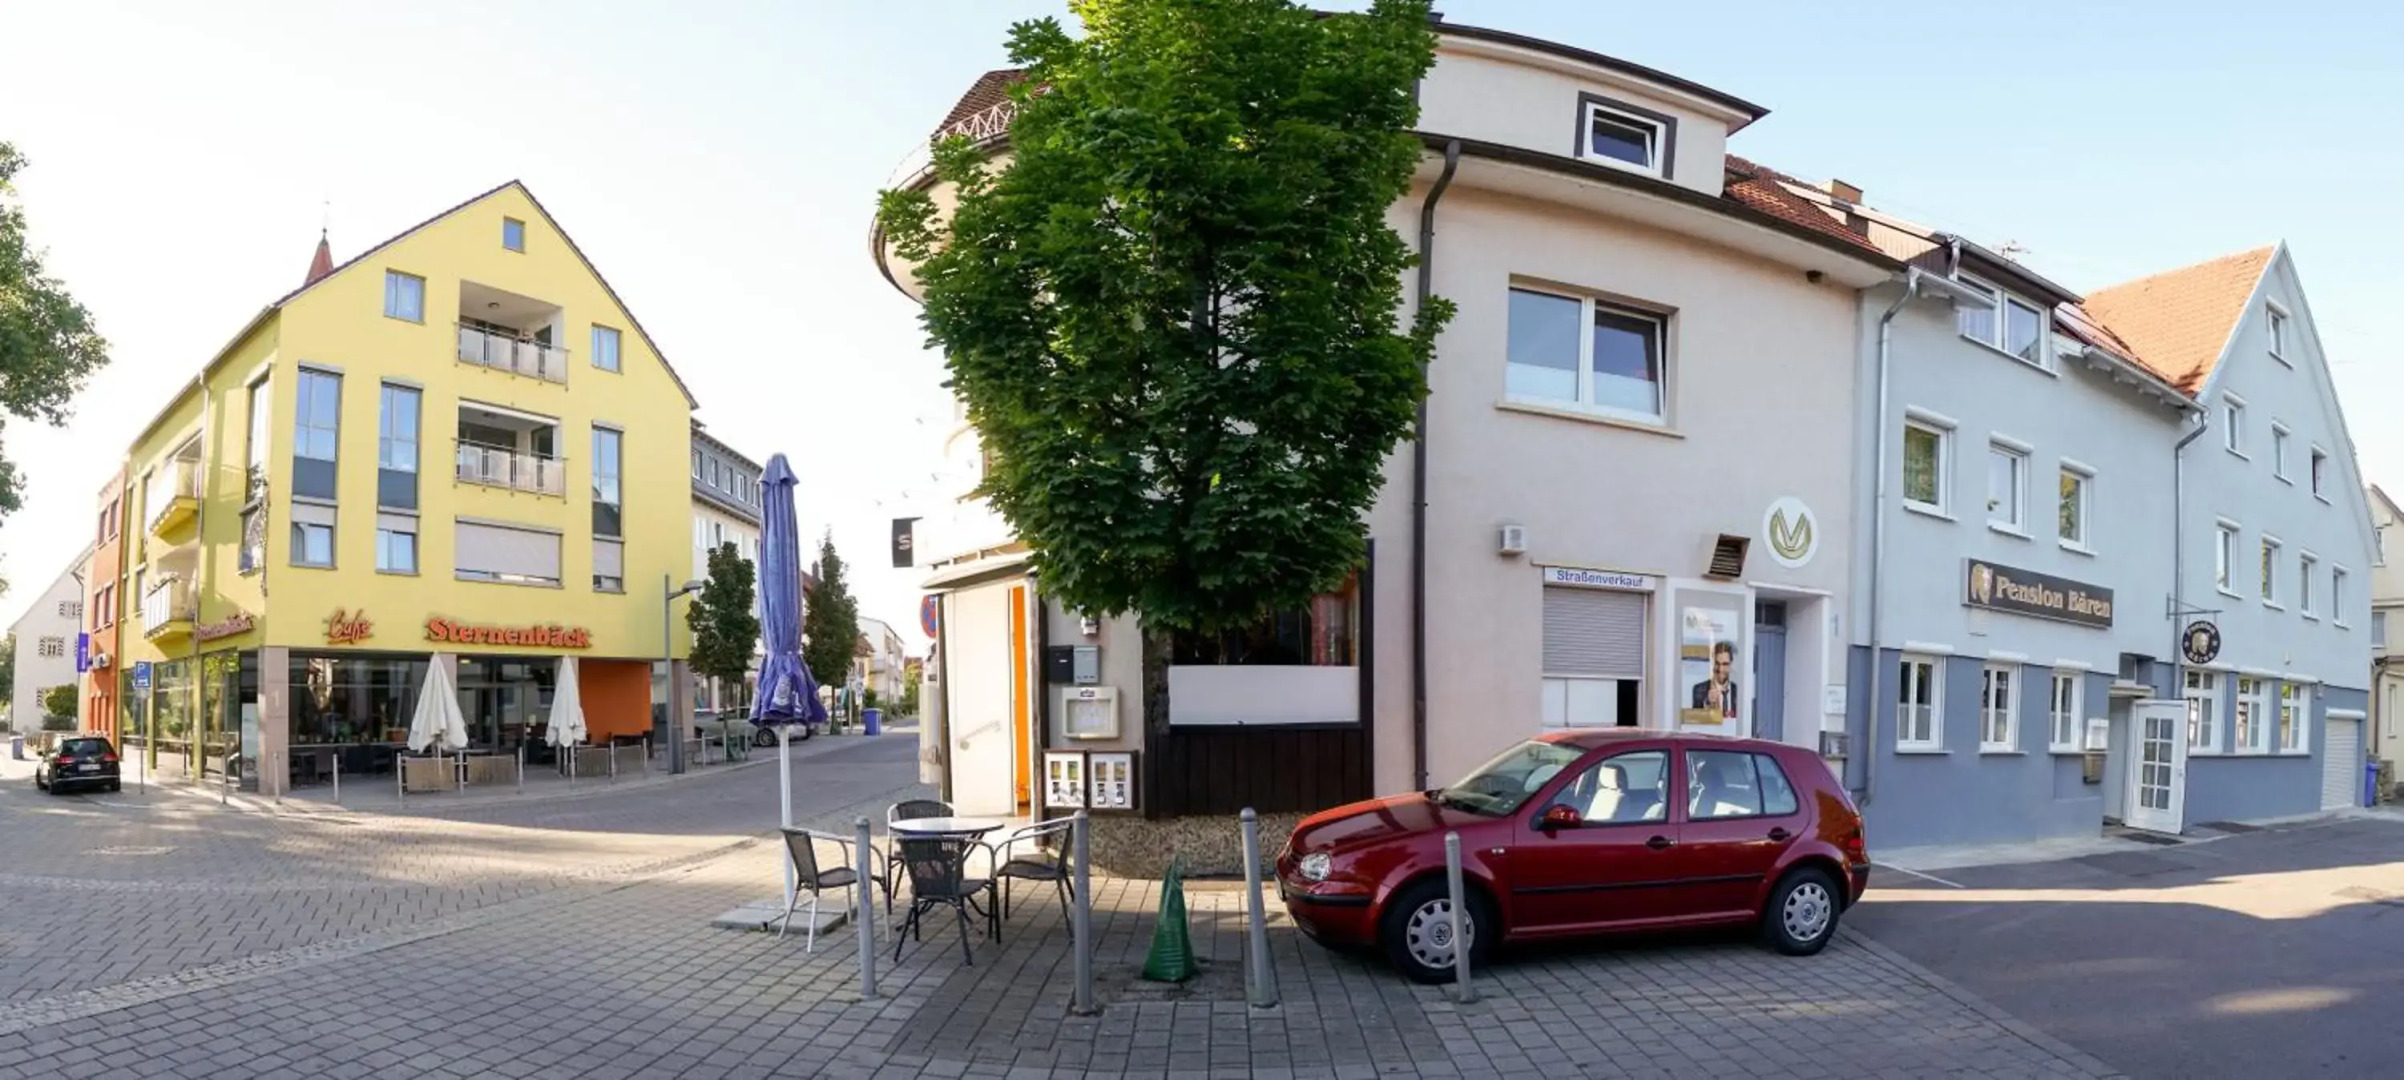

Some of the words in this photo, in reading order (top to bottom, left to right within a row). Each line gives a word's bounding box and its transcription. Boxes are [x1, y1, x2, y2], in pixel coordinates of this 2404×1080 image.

[1556, 570, 1644, 587] Straßenverkauf
[1996, 575, 2063, 609] Pension
[2068, 589, 2111, 617] Bären
[426, 617, 591, 648] Sternenbäck
